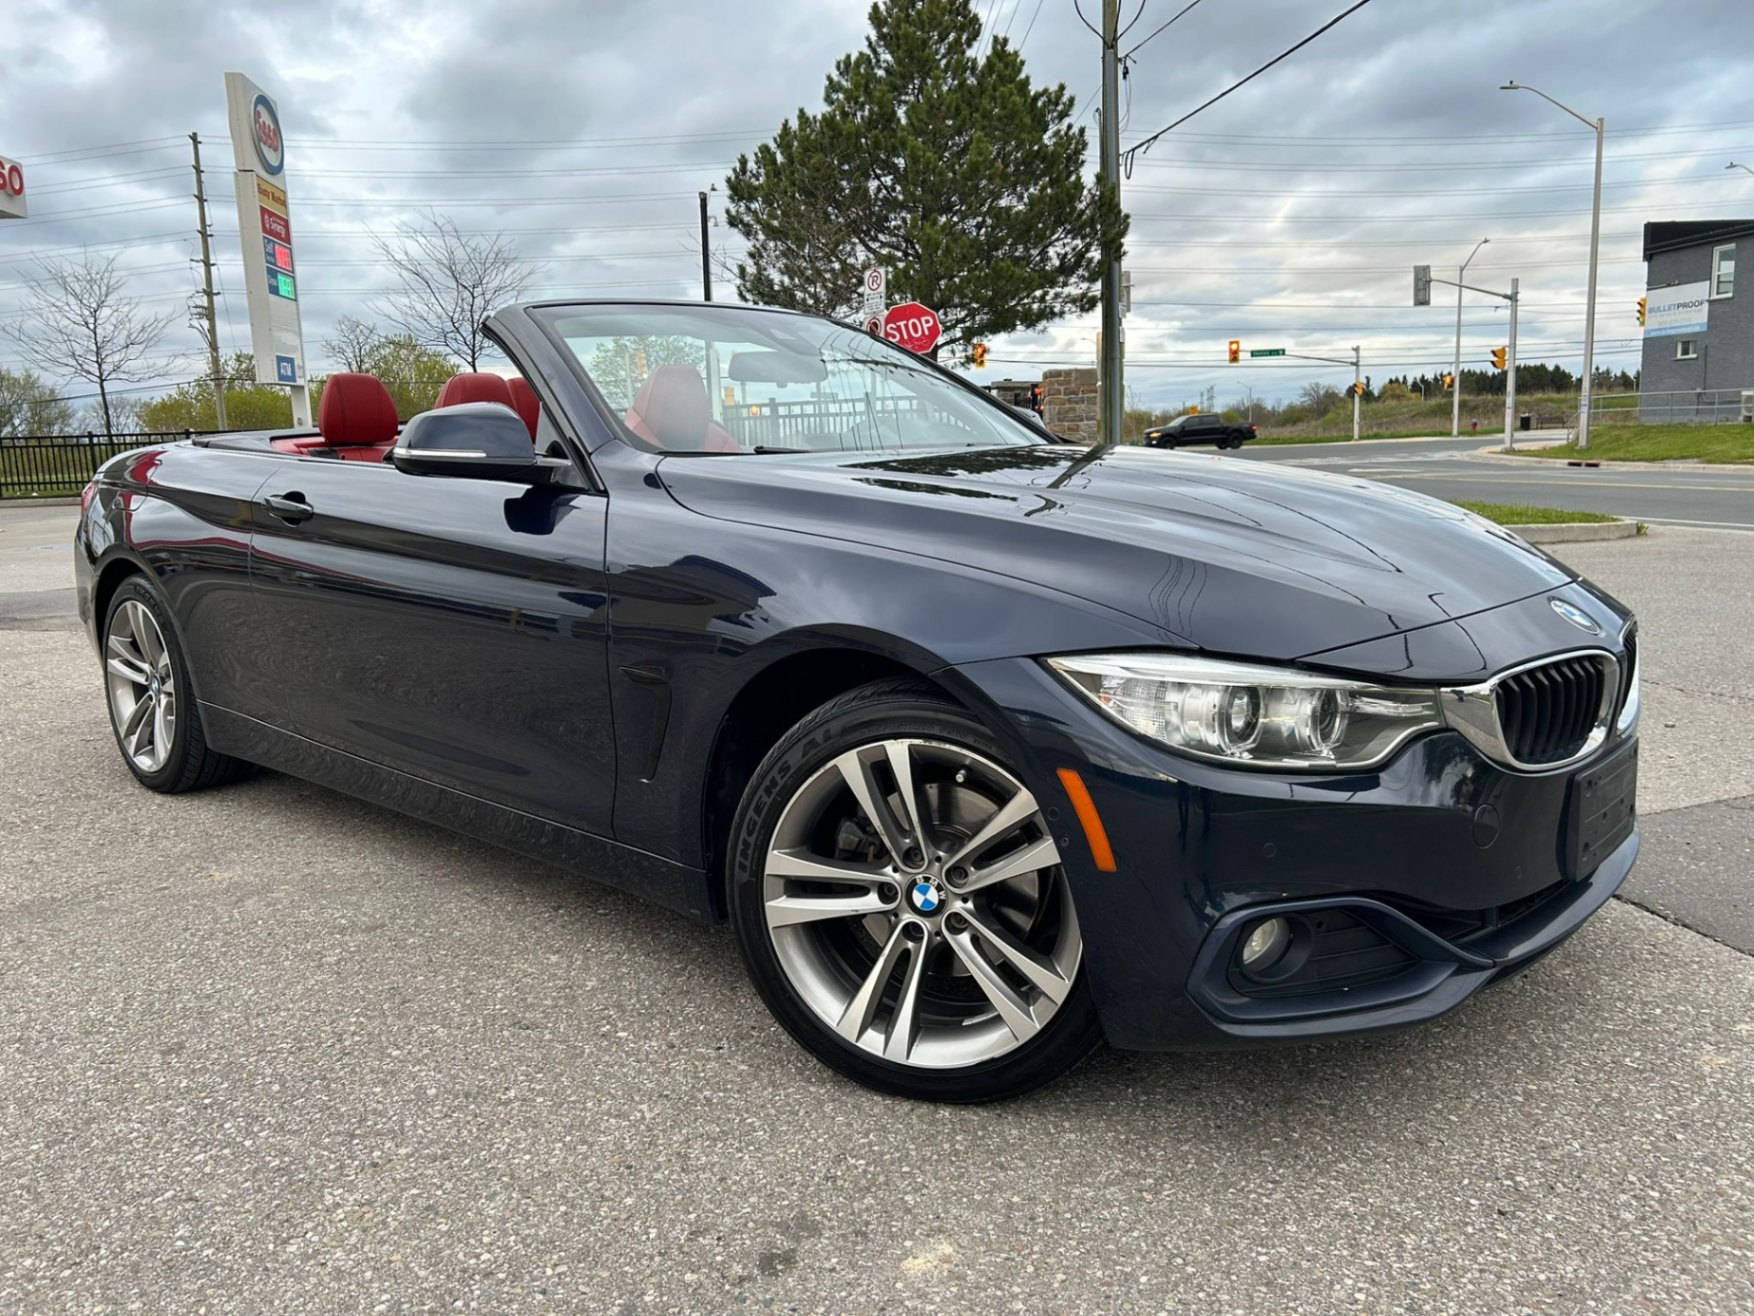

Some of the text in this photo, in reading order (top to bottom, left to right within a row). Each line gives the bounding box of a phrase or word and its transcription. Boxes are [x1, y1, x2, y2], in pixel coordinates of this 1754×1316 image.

[1647, 299, 1705, 314] BULLETPROOF
[886, 316, 934, 342] STOP
[738, 759, 792, 874] INGENS
[915, 874, 947, 900] BMW
